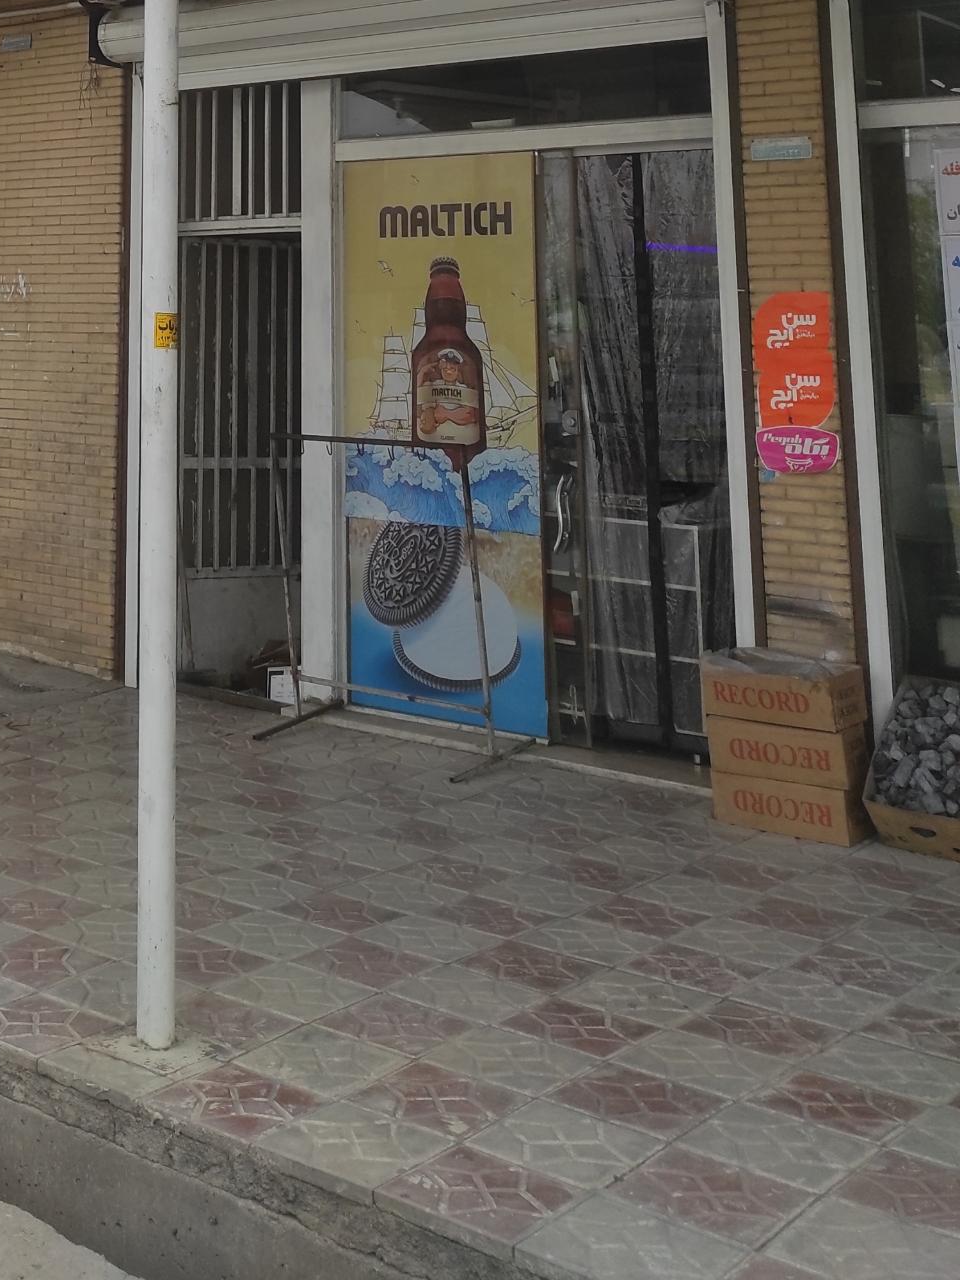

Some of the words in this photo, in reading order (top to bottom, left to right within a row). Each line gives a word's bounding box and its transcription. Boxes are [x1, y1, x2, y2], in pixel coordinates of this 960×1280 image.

[379, 201, 512, 238] MALTICH
[781, 312, 816, 327] سن
[766, 326, 794, 349] ایچ
[785, 373, 821, 388] سن
[431, 387, 462, 398] MALTICH
[770, 386, 798, 409] ایچ
[762, 432, 803, 447] Pegah
[784, 436, 831, 461] پگاه
[712, 681, 810, 714] RECORD
[729, 738, 832, 771] RECORD
[734, 790, 833, 828] RECORD
